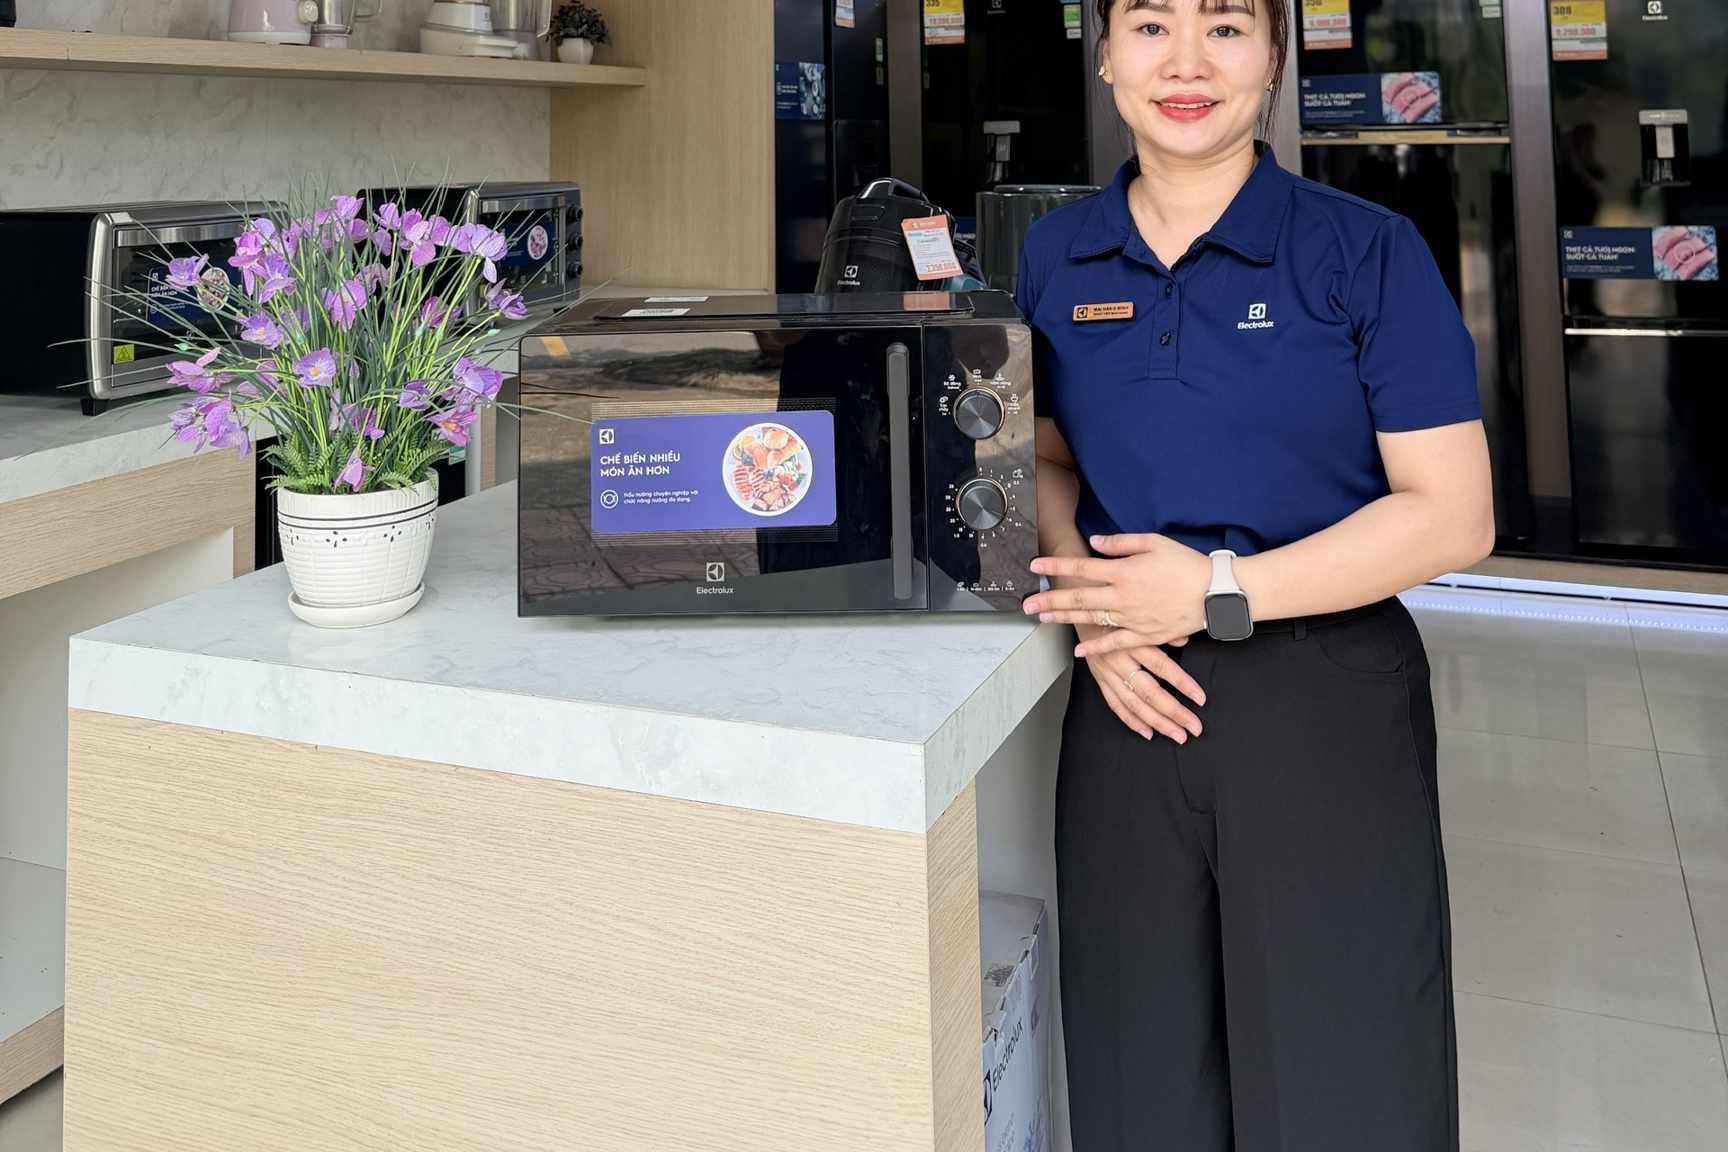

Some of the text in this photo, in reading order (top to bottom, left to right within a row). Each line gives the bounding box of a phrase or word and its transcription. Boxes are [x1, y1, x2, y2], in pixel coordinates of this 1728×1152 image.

[1237, 320, 1274, 330] Electrolux
[600, 450, 681, 465] CHẾ BIẾN NHIỀU
[600, 464, 670, 477] MÓN ĂN HƠN
[696, 586, 734, 594] Electrolux
